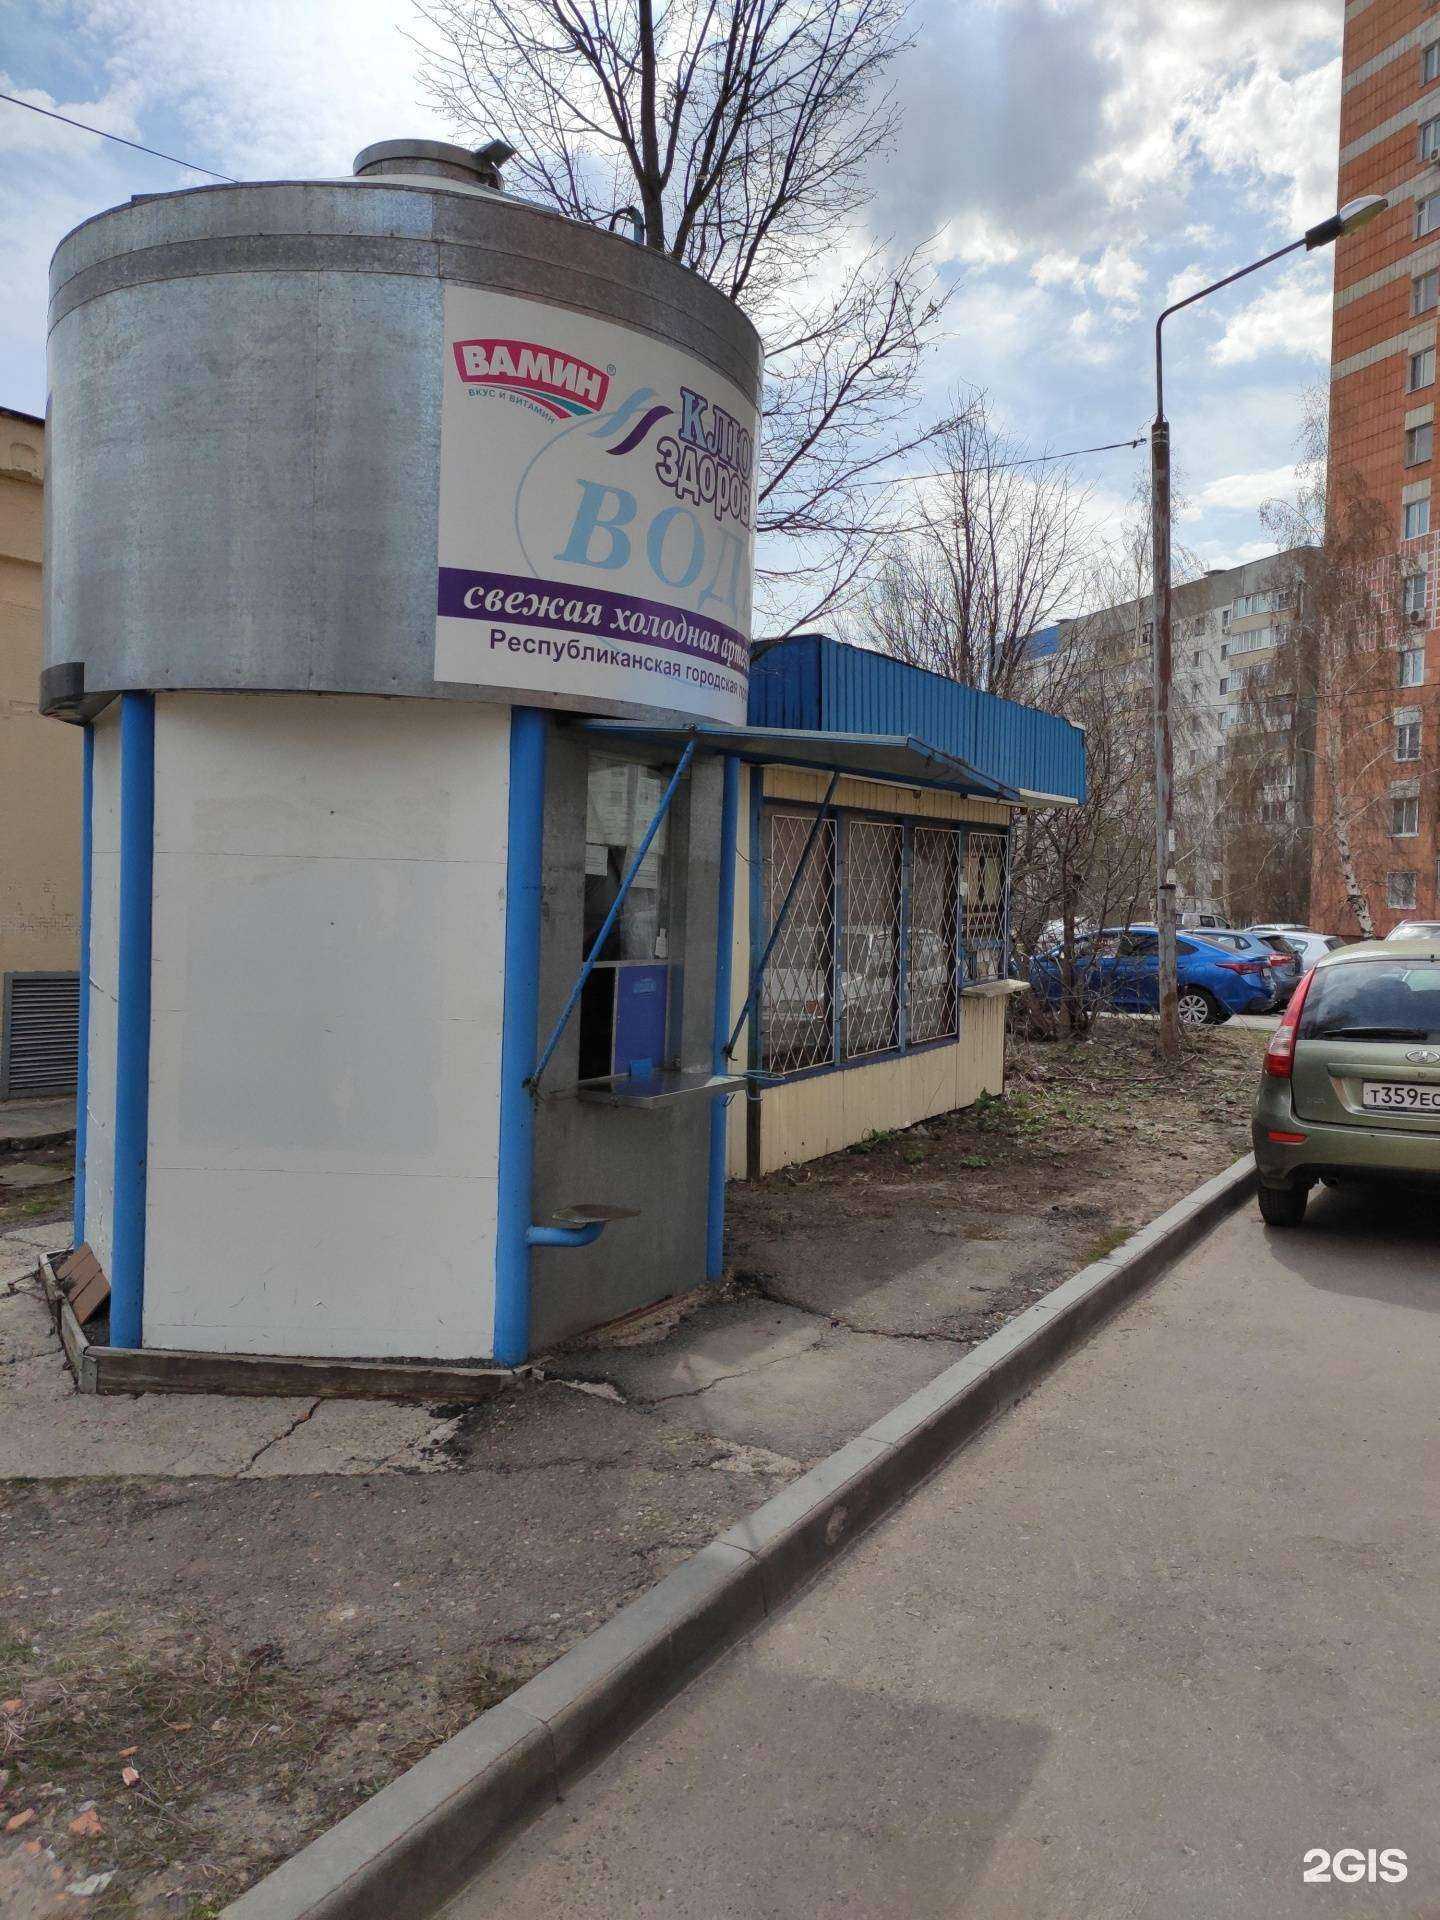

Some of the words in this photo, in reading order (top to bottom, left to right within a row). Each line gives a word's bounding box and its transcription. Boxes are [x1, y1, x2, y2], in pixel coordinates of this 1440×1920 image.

[462, 345, 602, 403] ВАМИН
[468, 388, 496, 397] ВКУС
[509, 395, 555, 425] ВИТАМИН
[463, 586, 603, 626] свежая
[610, 608, 719, 654] холодная
[720, 638, 750, 673] арте
[490, 628, 681, 678] Республиканская
[685, 665, 738, 695] городская
